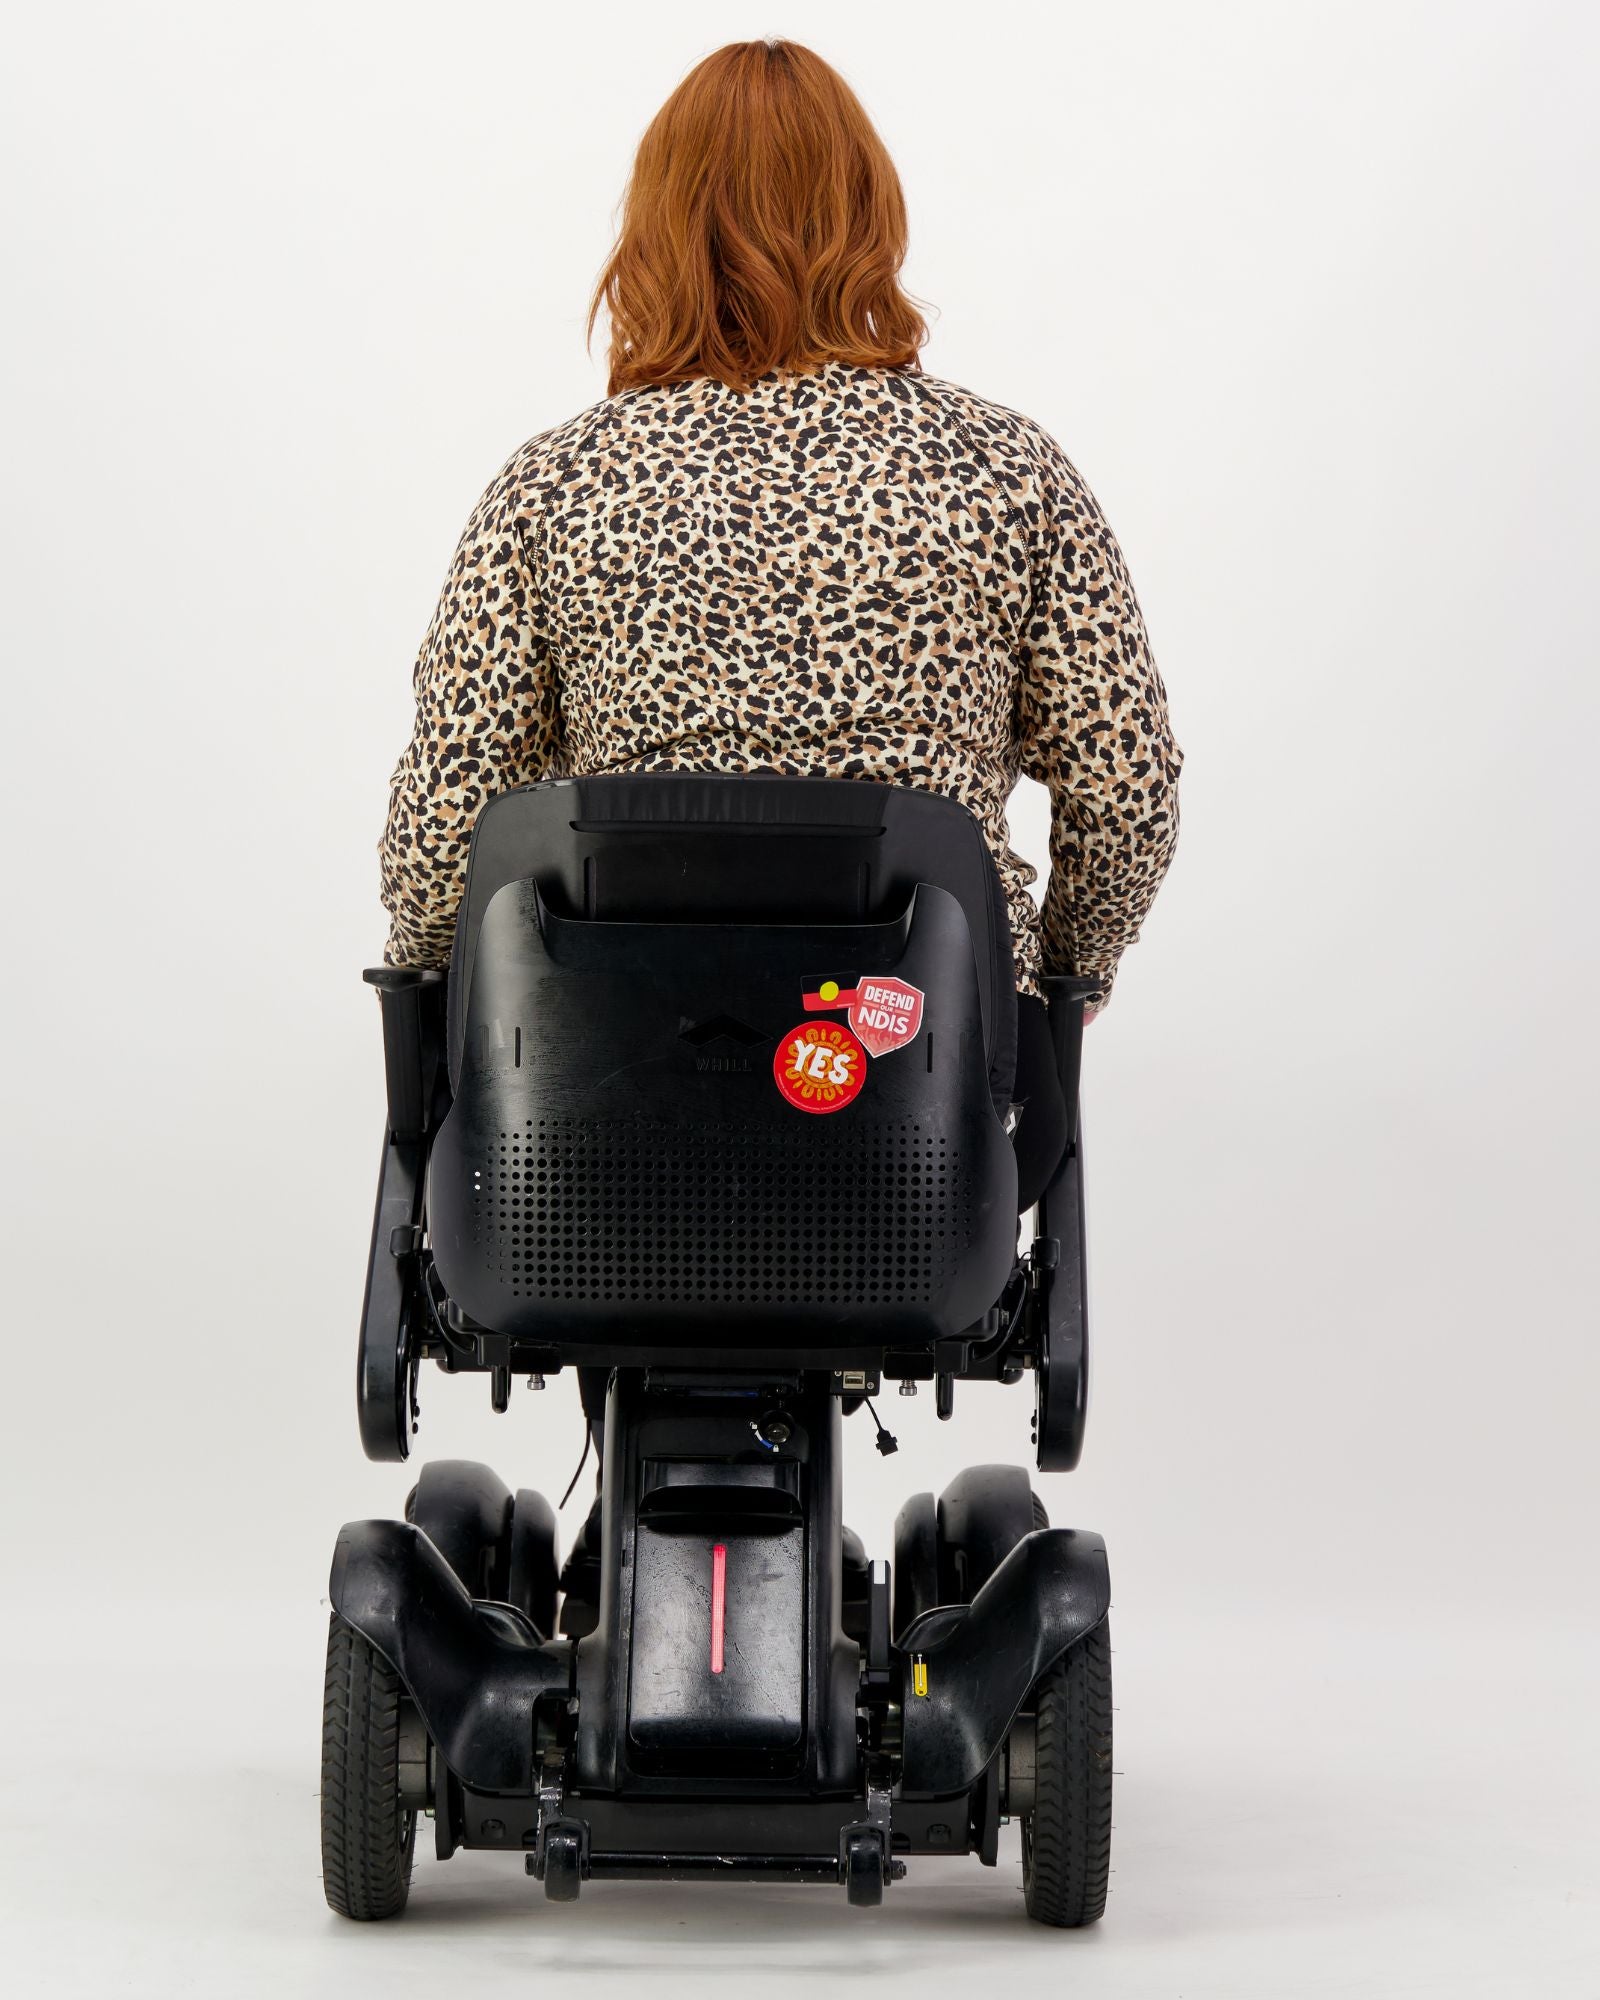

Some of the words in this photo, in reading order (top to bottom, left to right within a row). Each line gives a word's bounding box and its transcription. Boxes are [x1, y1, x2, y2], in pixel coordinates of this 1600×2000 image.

[864, 985, 915, 1011] DEFEND
[880, 1004, 894, 1012] OUR
[857, 1006, 910, 1035] NDIS
[696, 1057, 752, 1072] WHILL
[794, 1039, 851, 1085] YES
